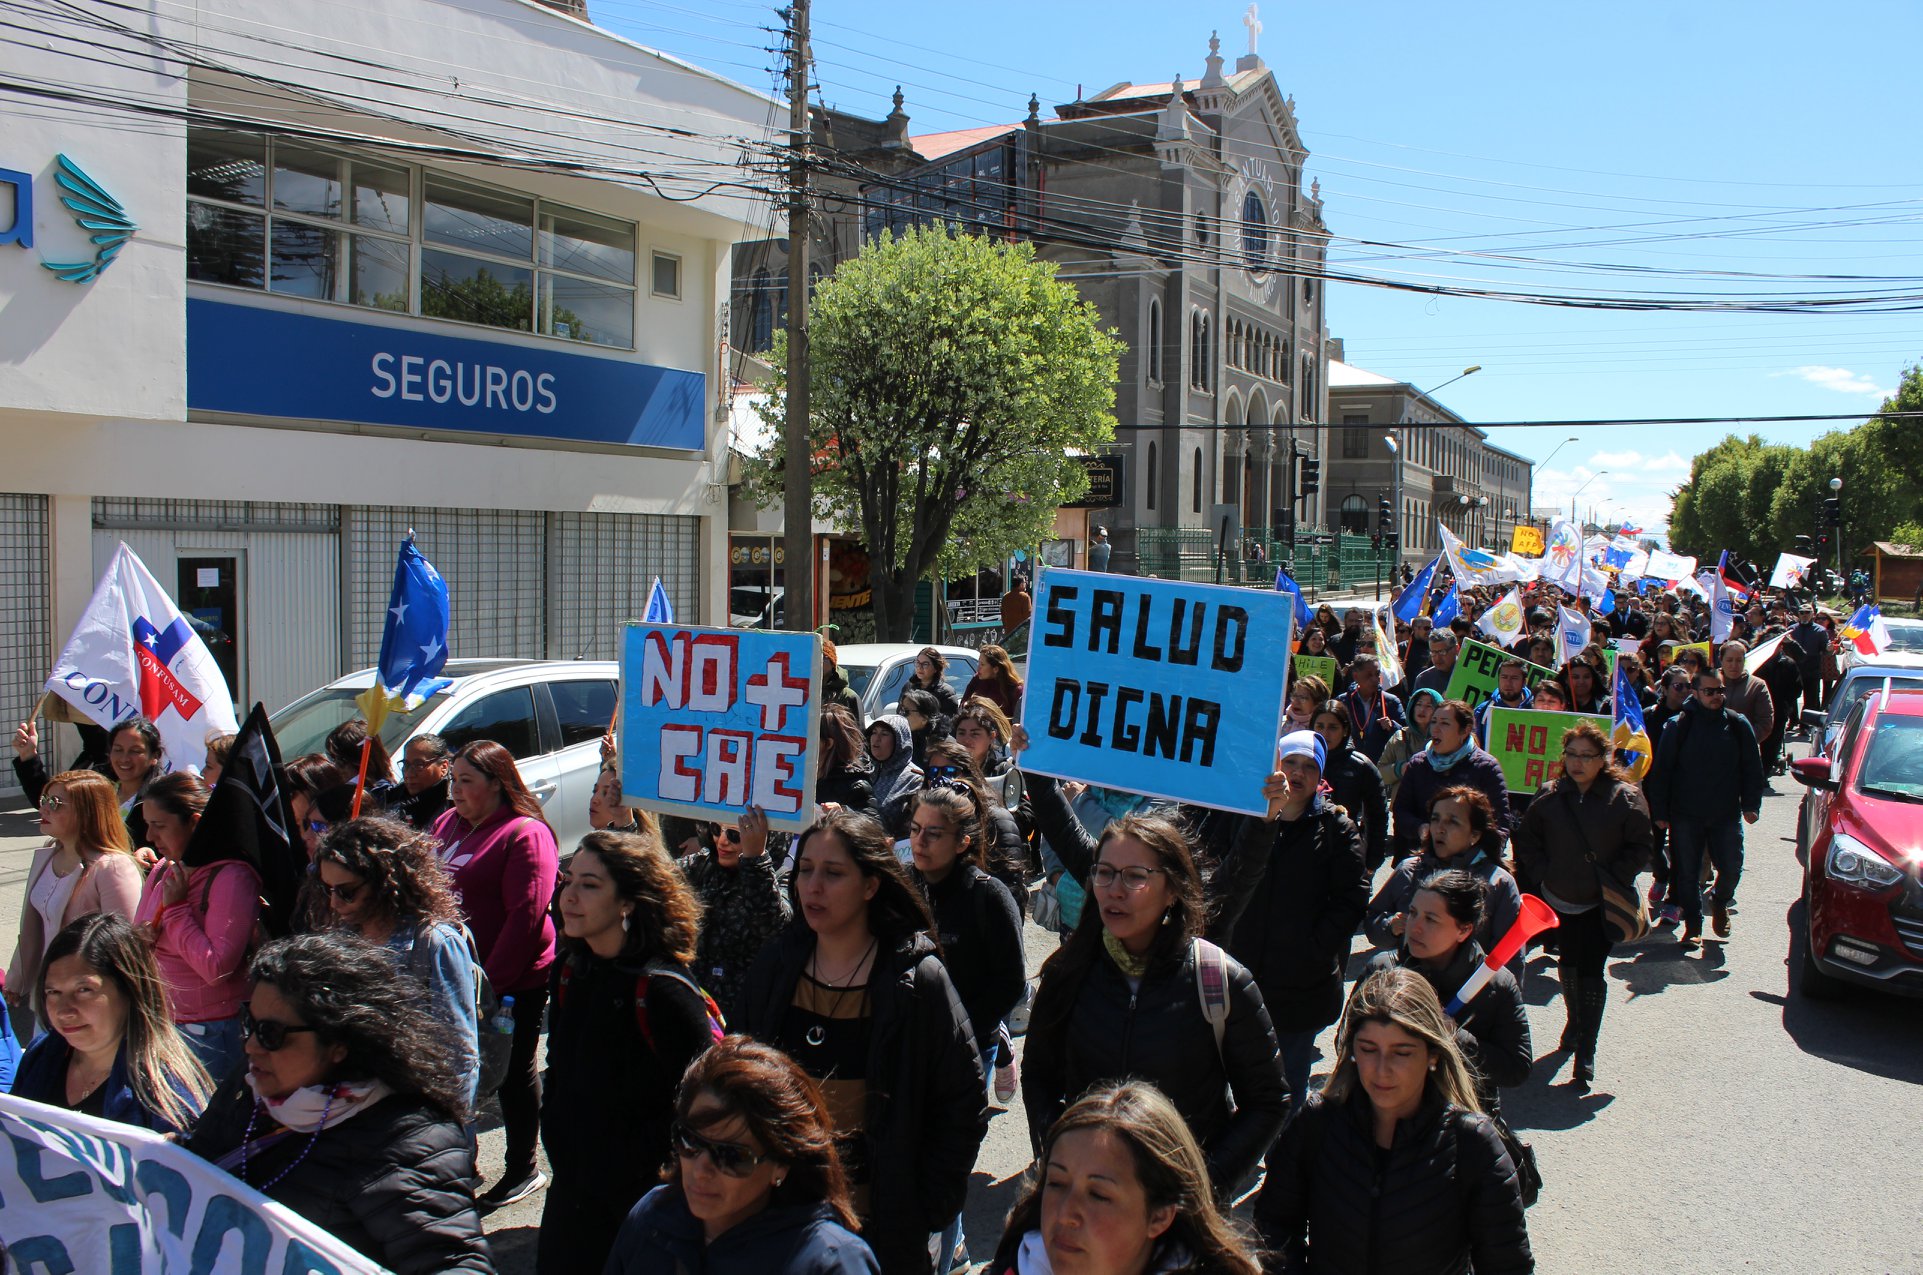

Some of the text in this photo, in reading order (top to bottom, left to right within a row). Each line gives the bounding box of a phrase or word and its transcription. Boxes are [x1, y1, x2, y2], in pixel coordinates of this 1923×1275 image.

[1234, 157, 1280, 225] SANTUARIO
[371, 352, 557, 414] SEGUROS
[1089, 474, 1111, 483] TERÍA
[1044, 585, 1249, 673] SALUD
[137, 651, 189, 706] CONFUSAM
[641, 630, 740, 713] NO
[1047, 677, 1221, 768] DIGNA
[1505, 723, 1548, 755] NO
[658, 723, 807, 813] CAE
